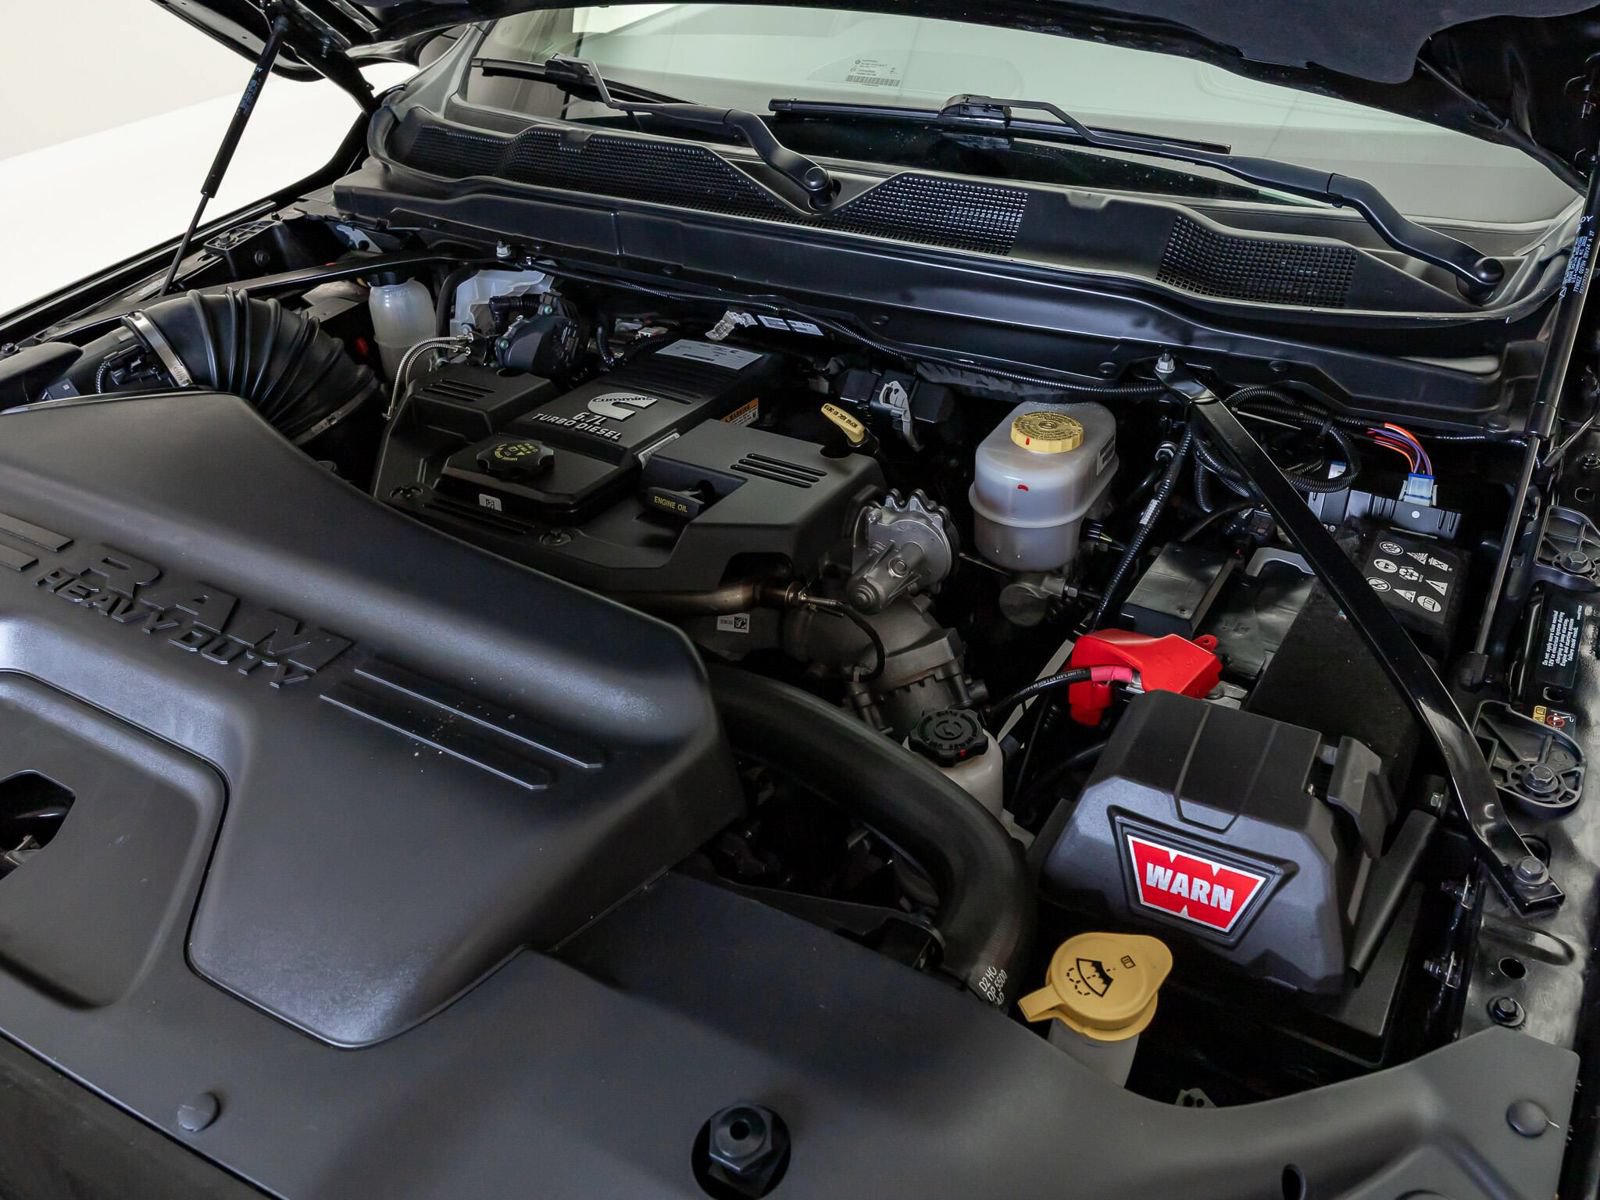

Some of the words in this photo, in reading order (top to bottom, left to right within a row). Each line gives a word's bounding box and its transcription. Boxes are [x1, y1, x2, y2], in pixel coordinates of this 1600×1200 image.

[532, 413, 576, 426] TURBO
[575, 423, 622, 440] DIESEL
[572, 412, 607, 425] 6.7L
[654, 496, 675, 509] ENGINE
[677, 504, 688, 512] OIL
[36, 567, 180, 633] HEAVY
[168, 630, 310, 688] DUTY
[81, 546, 355, 672] RAM
[1146, 862, 1234, 912] WARN
